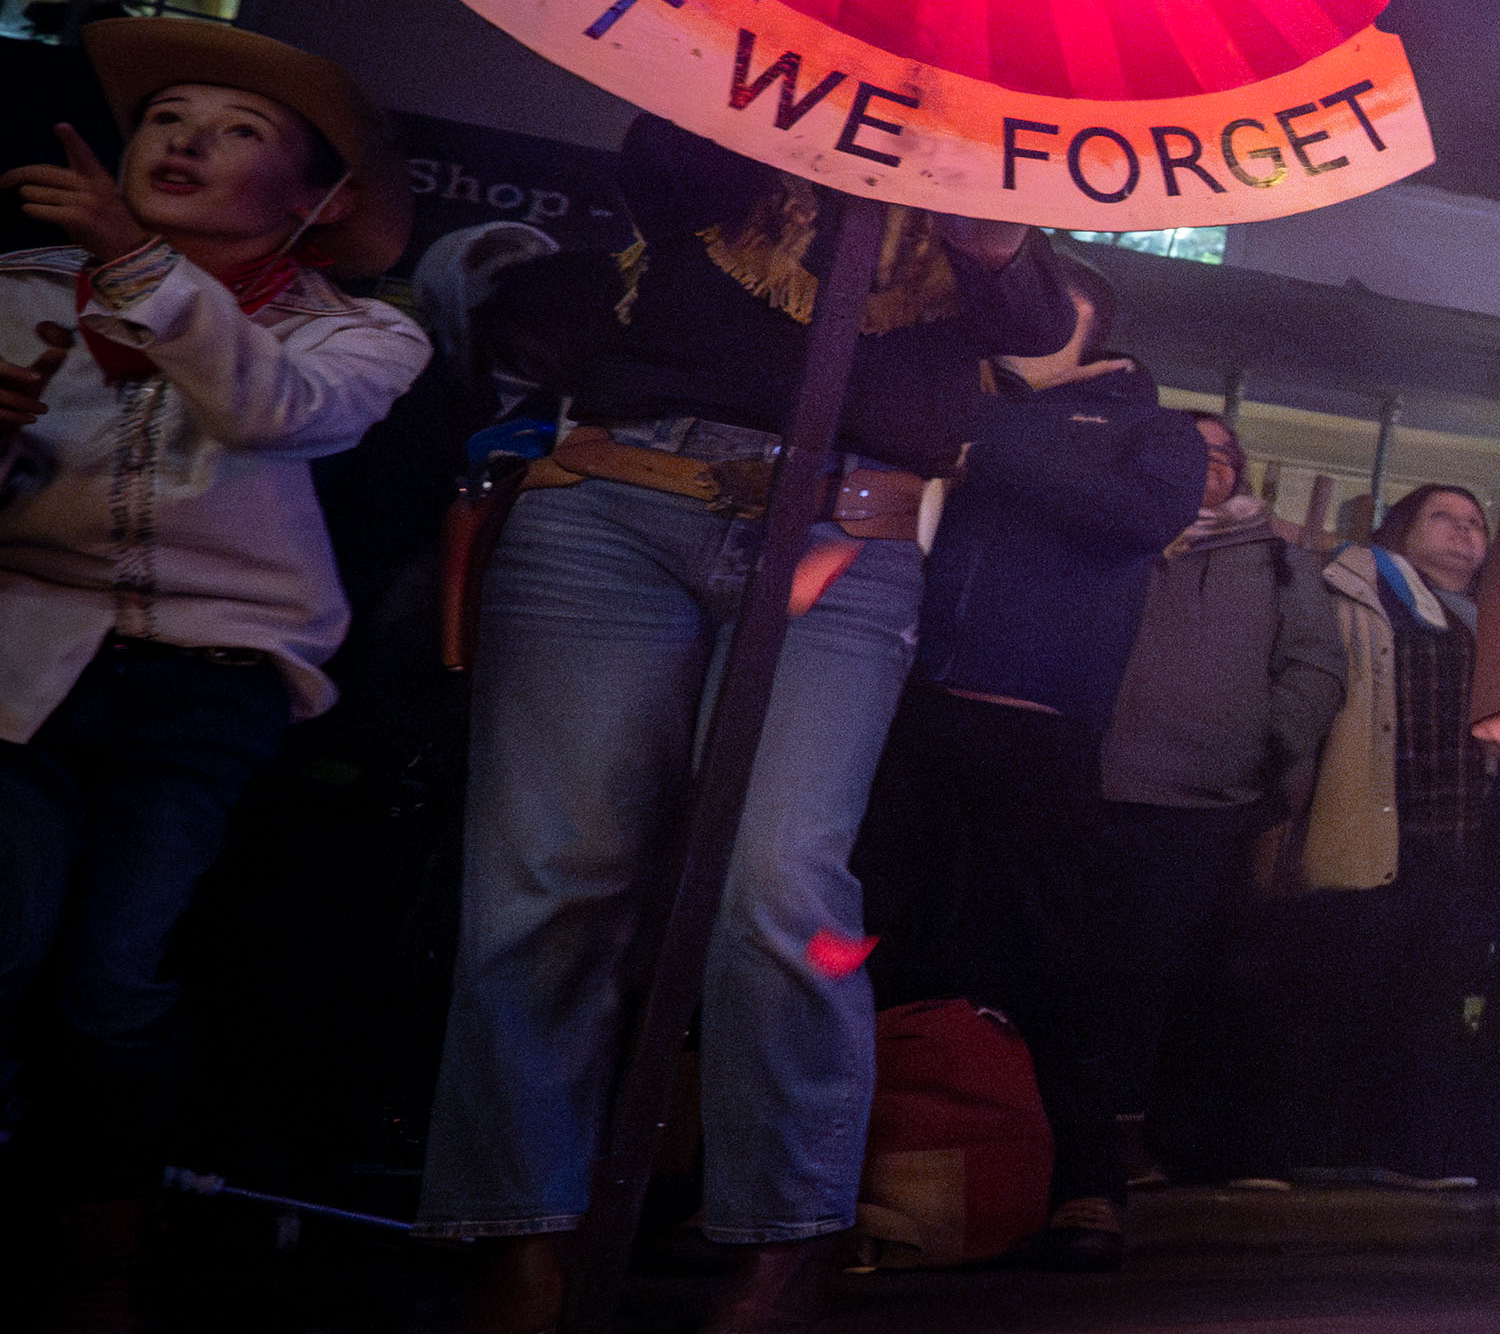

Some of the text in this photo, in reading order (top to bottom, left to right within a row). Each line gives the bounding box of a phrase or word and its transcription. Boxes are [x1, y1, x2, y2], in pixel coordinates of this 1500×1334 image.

[728, 28, 920, 167] WE
[1001, 79, 1388, 203] FORGET
[408, 158, 571, 224] Shop
